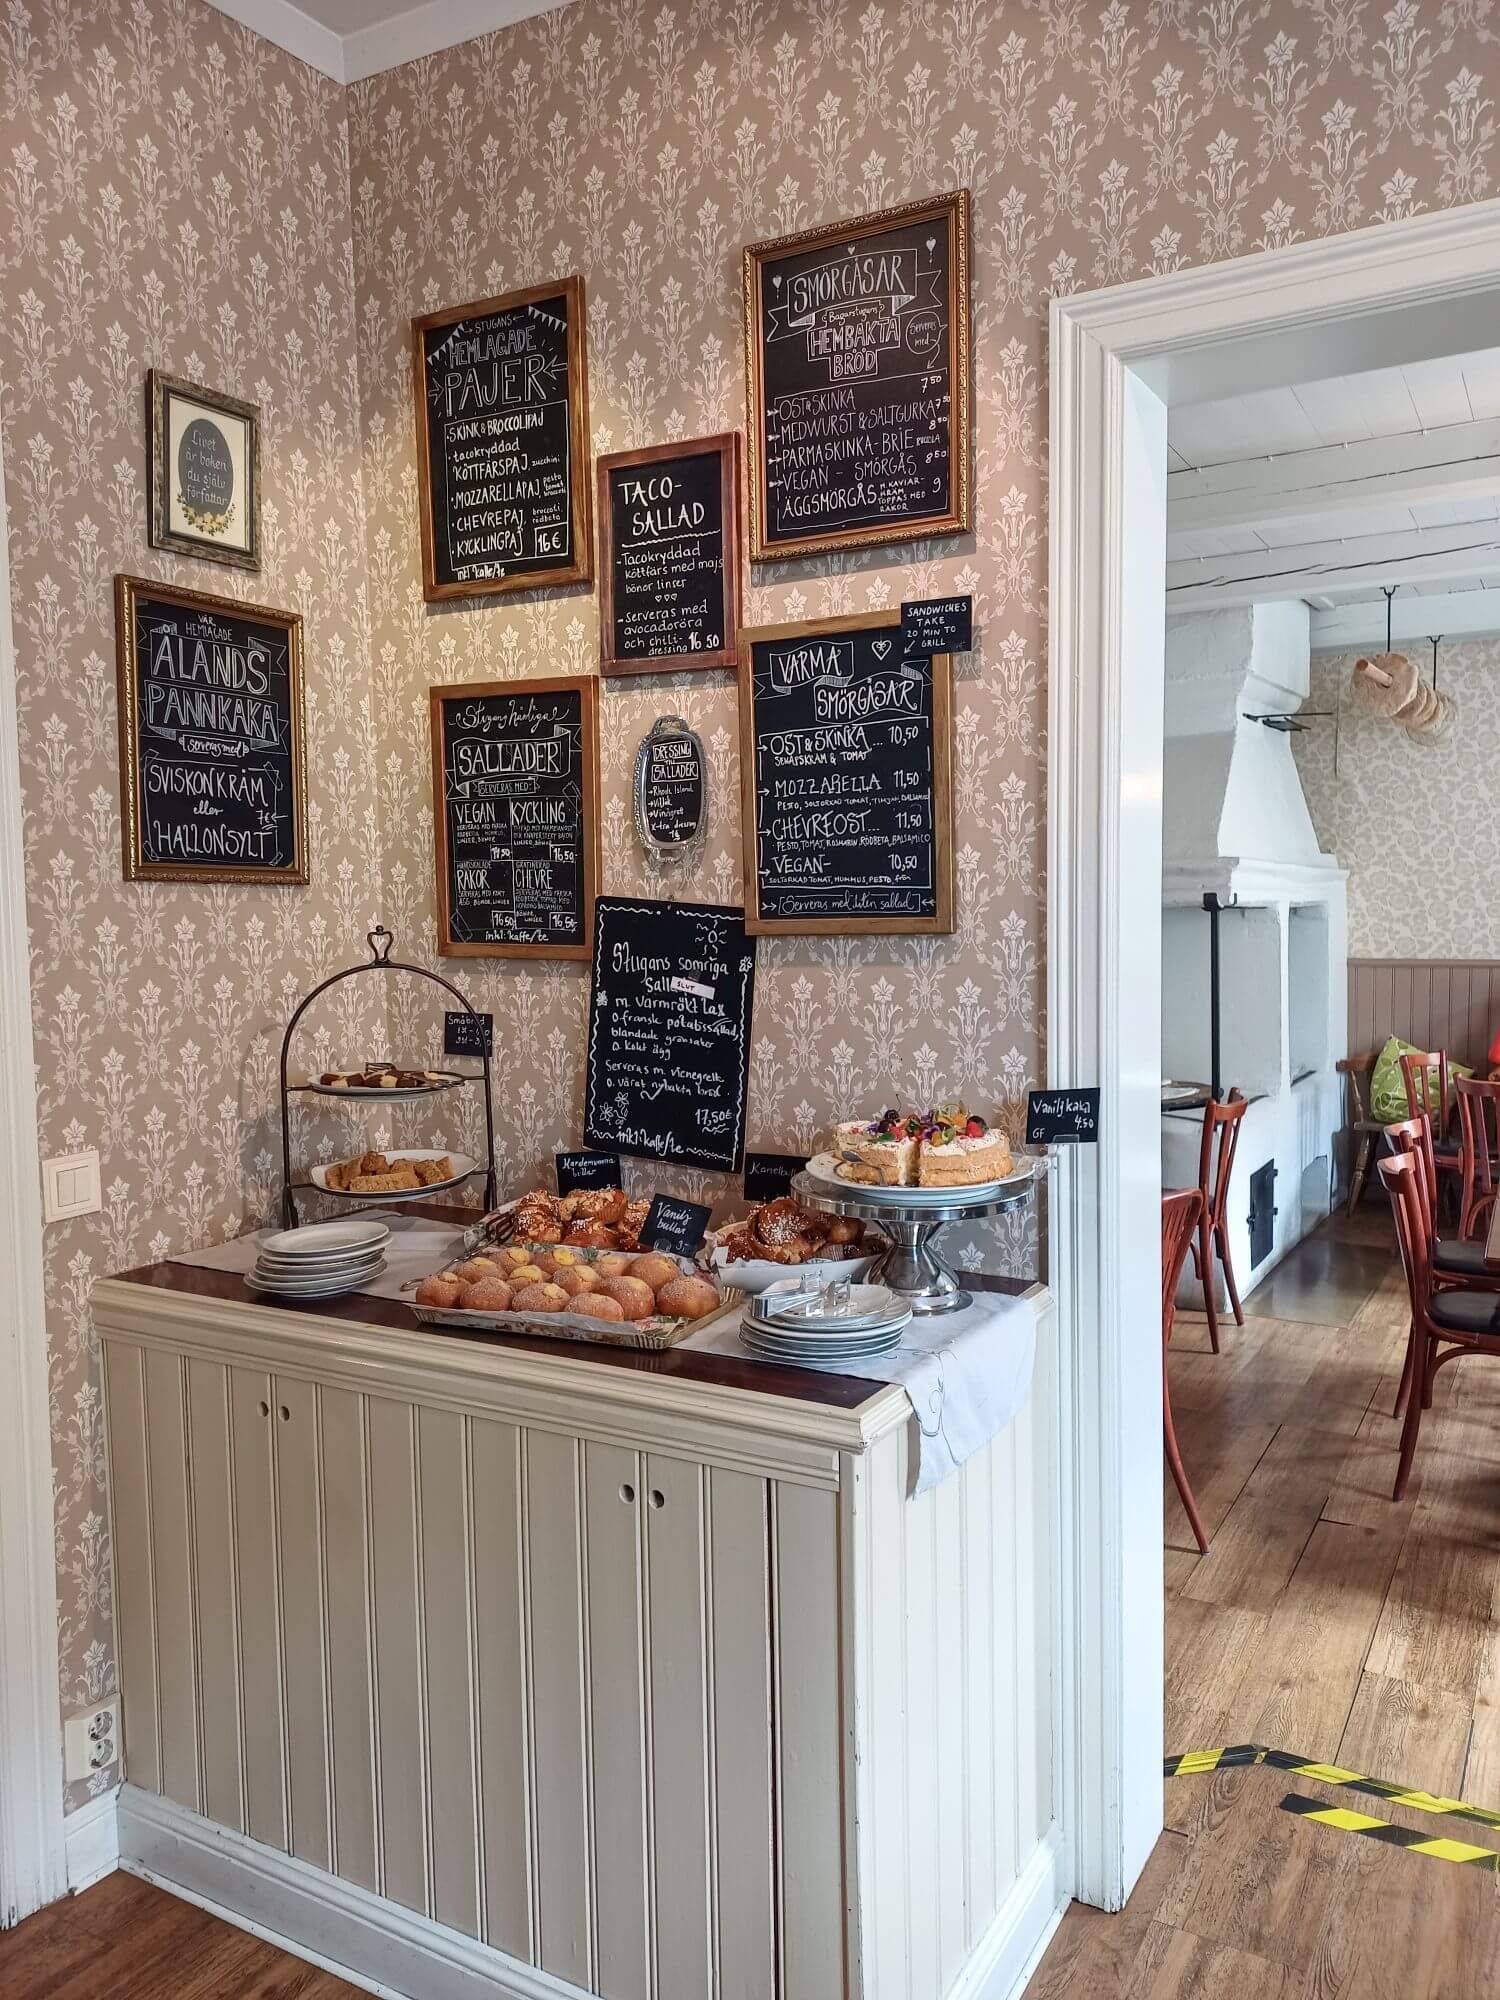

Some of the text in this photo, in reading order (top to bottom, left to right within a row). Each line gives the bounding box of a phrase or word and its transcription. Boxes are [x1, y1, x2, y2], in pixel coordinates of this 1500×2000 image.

[475, 313, 512, 334] STUGANS
[450, 325, 537, 369] HEMLAGADE
[811, 318, 900, 357] HEMBAKTA
[833, 348, 877, 378] BRÖD
[445, 354, 547, 417] PAJER
[781, 412, 857, 446] MEDWURST
[453, 437, 520, 463] tacokryddad
[200, 450, 228, 472] boken
[187, 468, 200, 483] du
[783, 457, 917, 491] VEGAN SMÖRGÅS
[782, 477, 941, 520] ÄGGSMÖRGÅS 9
[633, 502, 705, 537] SALLAD
[457, 530, 523, 558] KYCKLINGPAJ
[671, 558, 696, 575] med
[698, 556, 724, 574] majs
[625, 575, 687, 594] bönor linser
[681, 598, 709, 617] med
[907, 607, 968, 623] SANDWICHES
[624, 617, 704, 637] avocadoröra
[907, 625, 957, 642] 20 MIN TO
[917, 616, 946, 632] TAKE
[624, 634, 646, 649] och
[648, 643, 688, 656] dressing
[921, 639, 946, 653] GRILL
[778, 646, 842, 684] VARMA
[817, 677, 919, 720] SMÖRGÅSAR
[149, 684, 277, 744] PANNKAKA
[458, 742, 562, 776] SALLADER
[654, 743, 690, 759] DRESSING
[829, 749, 869, 765] & TOMAT
[654, 763, 697, 780] SALLADER
[774, 773, 882, 799] MOZZARELLA
[193, 800, 224, 816] eller
[455, 798, 566, 826] VEGAN KYCKLING
[153, 822, 273, 860] HALLONSYLT
[515, 868, 553, 890] CHEVRE
[782, 896, 828, 913] Serveras
[832, 891, 852, 910] med
[880, 891, 914, 910] sallad
[612, 941, 671, 982] Stugans
[677, 979, 697, 992] SLUT
[448, 1014, 485, 1025] Småbrd
[605, 1060, 650, 1075] Serveras
[1032, 1127, 1045, 1139] GF
[657, 1221, 687, 1235] bullar
